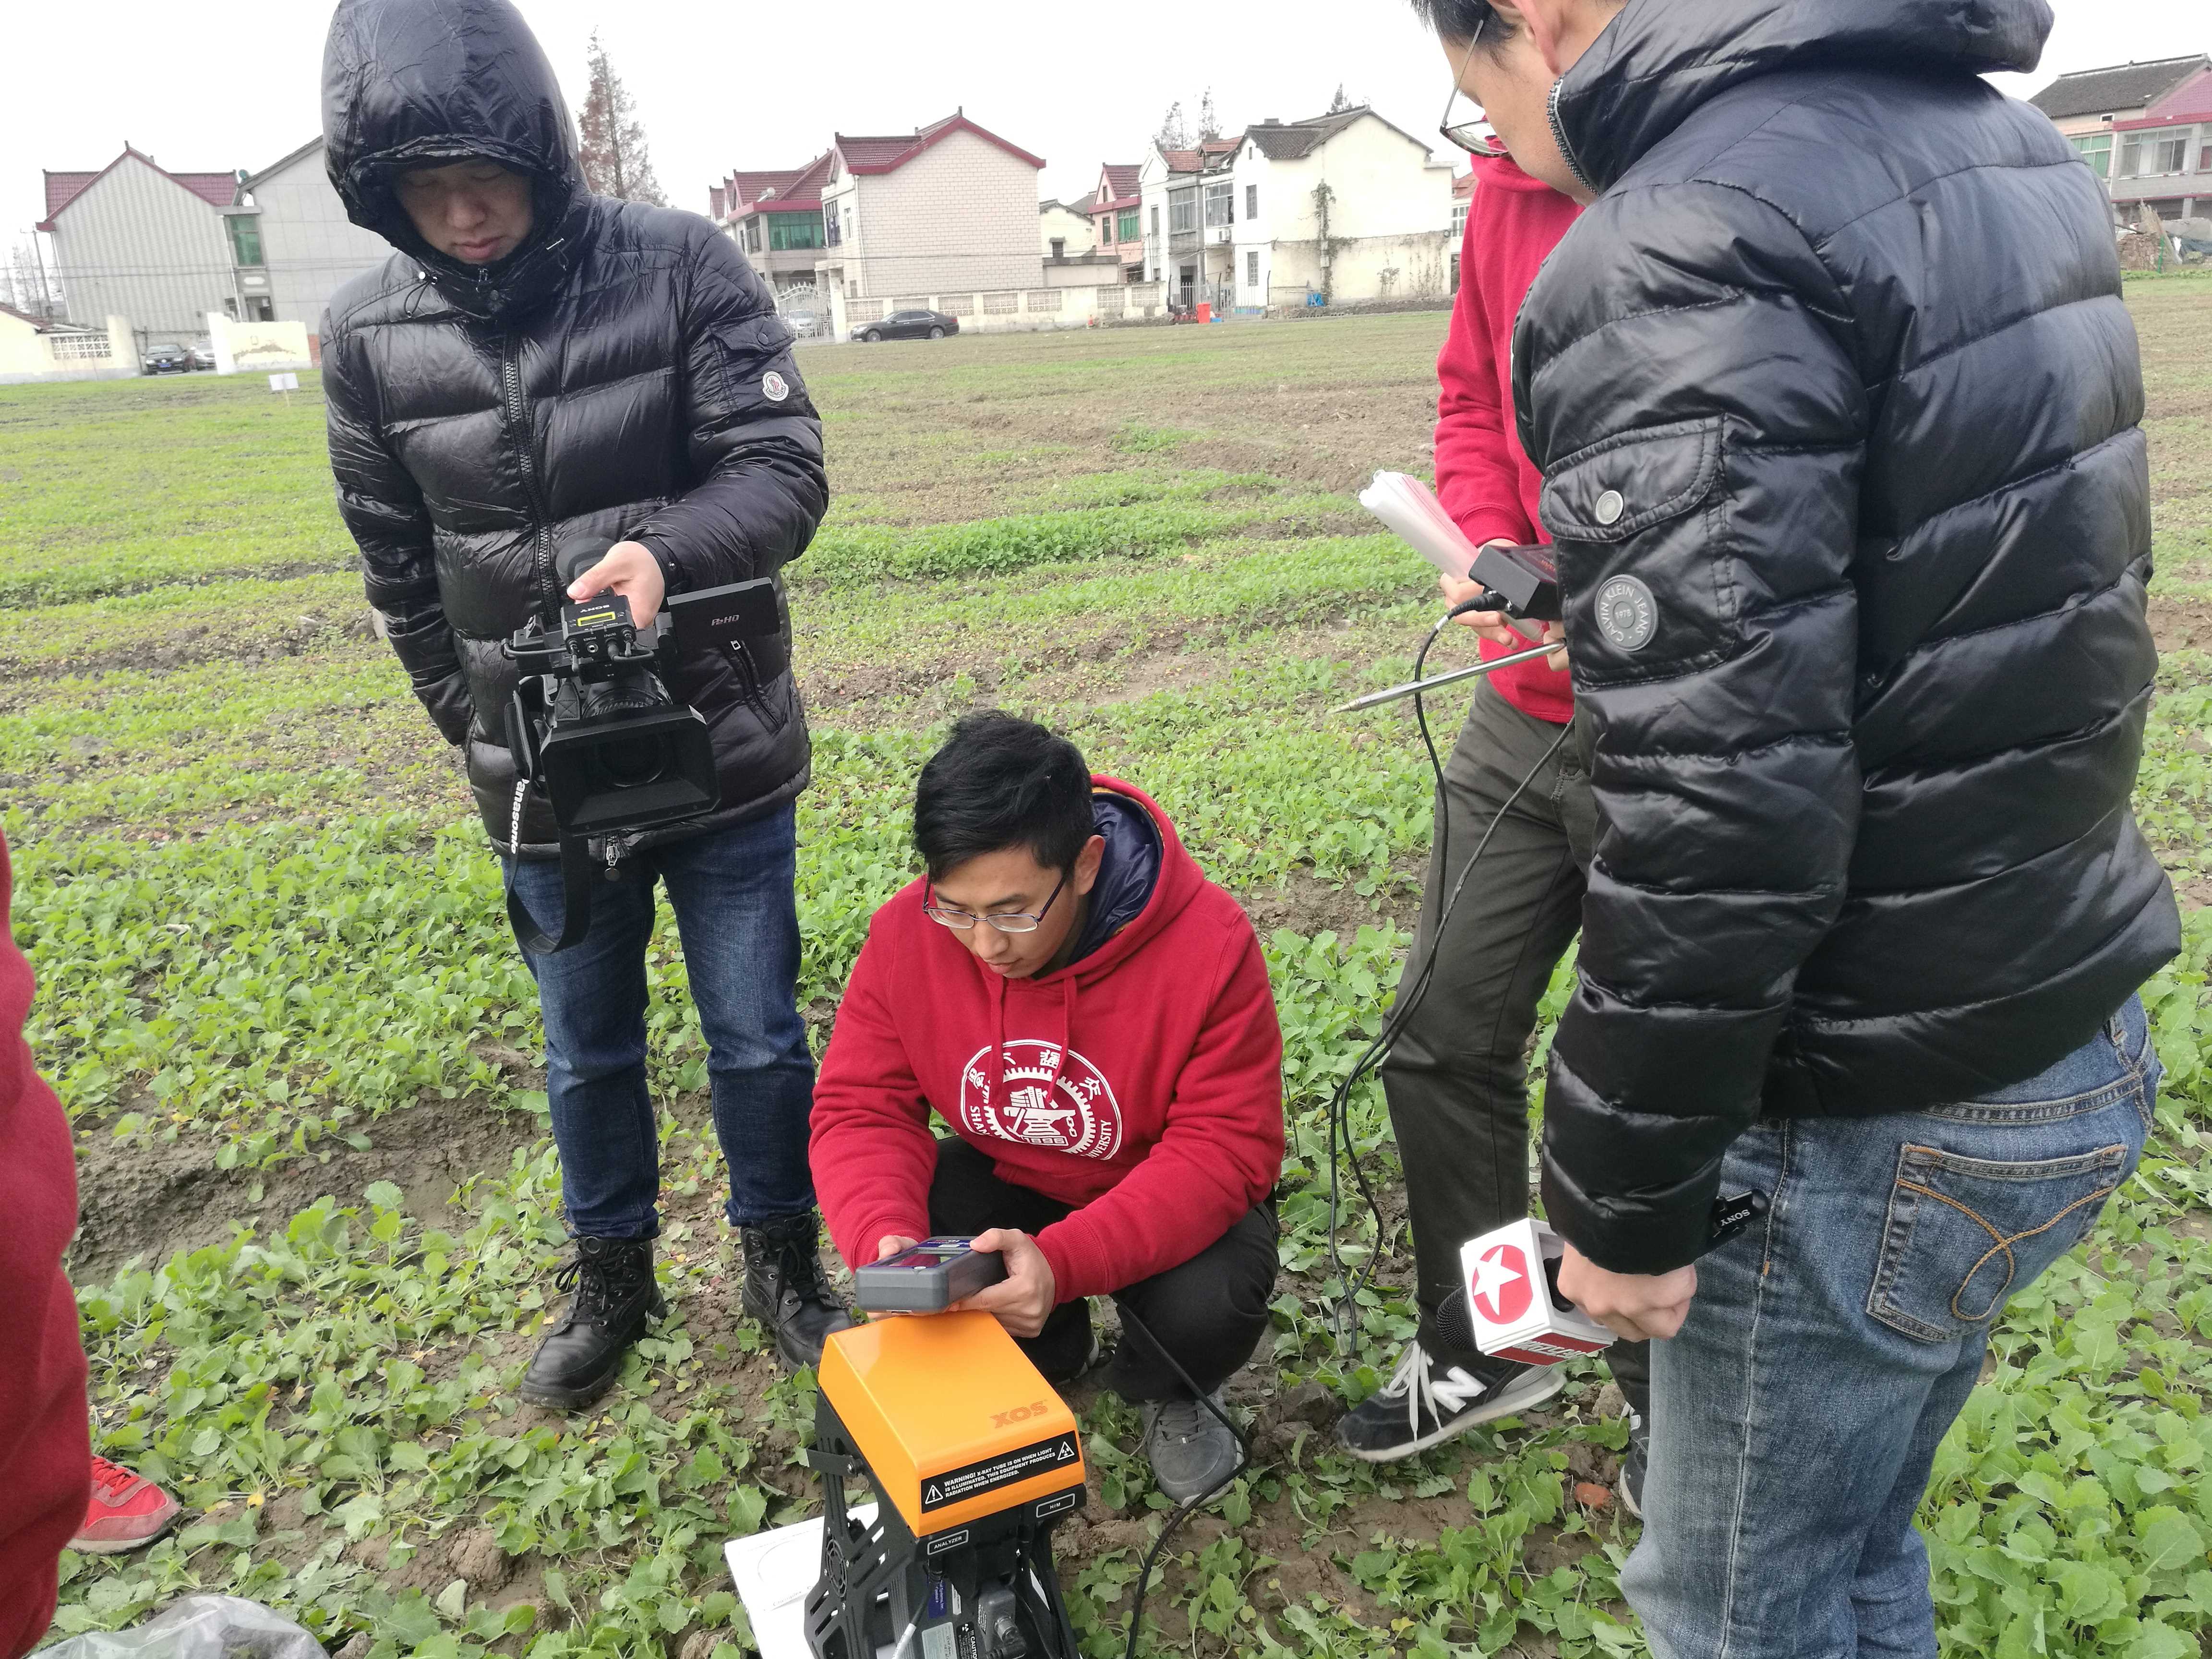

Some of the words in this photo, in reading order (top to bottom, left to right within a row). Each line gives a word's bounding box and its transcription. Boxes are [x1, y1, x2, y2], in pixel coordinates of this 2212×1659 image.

[1605, 585, 1635, 601] KLEIN
[580, 604, 610, 613] SONY
[1601, 602, 1624, 641] CALVIN
[1635, 597, 1649, 636] JEANS
[970, 1106, 990, 1136] SHAN
[1082, 1120, 1112, 1159] NIVERSITY
[1720, 1209, 1751, 1226] SONY
[989, 1401, 1048, 1429] XOS
[944, 1473, 976, 1487] WARNING!
[977, 1468, 992, 1476] X-RAY
[1022, 1453, 1036, 1462] WHEN
[1037, 1447, 1052, 1457] LIGHT
[951, 1476, 986, 1490] ILLUMINATED.
[1000, 1461, 1028, 1475] EQUIPMENT
[1029, 1452, 1056, 1464] PRODUCES
[946, 1485, 973, 1497] RADIATION
[974, 1479, 989, 1489] WHEN
[990, 1470, 1019, 1484] ENERGIZED.
[1050, 1502, 1061, 1510] HIM
[934, 1536, 962, 1550] ANALYZER
